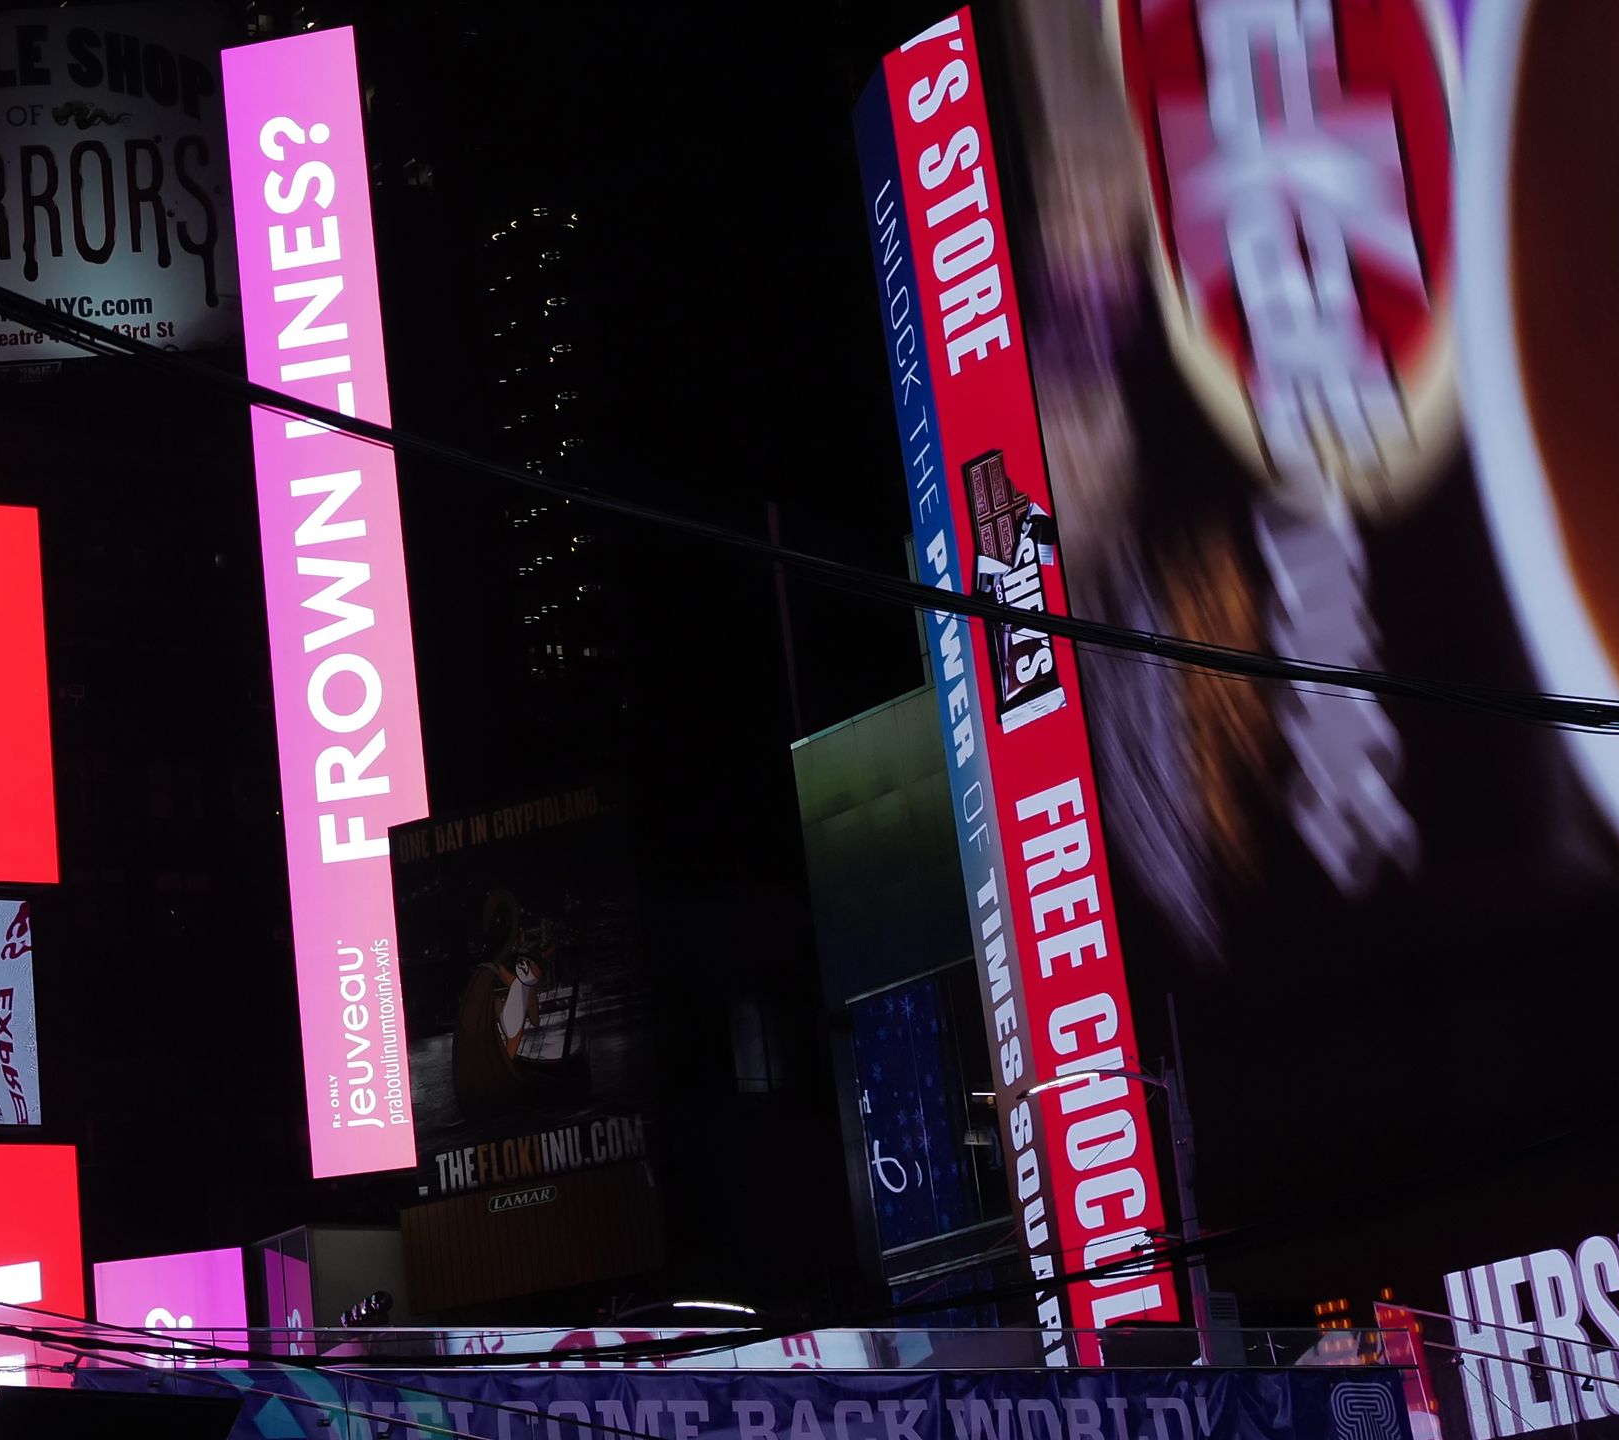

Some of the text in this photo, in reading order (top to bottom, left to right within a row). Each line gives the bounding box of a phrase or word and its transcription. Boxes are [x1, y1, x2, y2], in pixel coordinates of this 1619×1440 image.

[6, 105, 43, 126] OF
[67, 28, 216, 119] SHOP
[874, 179, 921, 406] UNLOCK
[918, 127, 1011, 376] STORE
[157, 322, 175, 337] St
[260, 114, 392, 866] FROWN LINES?
[906, 413, 940, 523] THE
[398, 830, 430, 864] ONE
[435, 819, 465, 853] DAY
[470, 814, 487, 845] IN
[963, 781, 992, 852] OF
[977, 866, 1023, 1088] TIMES
[370, 938, 410, 1124] prabotulinumtoxinA-xvfs
[1016, 777, 1165, 1367] FREE CHOCOL
[329, 1074, 339, 1108] ONLY
[435, 1116, 646, 1193] THEFLOKIINU.COM
[494, 1188, 553, 1211] LAMAR
[732, 1399, 929, 1440] BACK
[946, 1396, 1211, 1440] WORLD!
